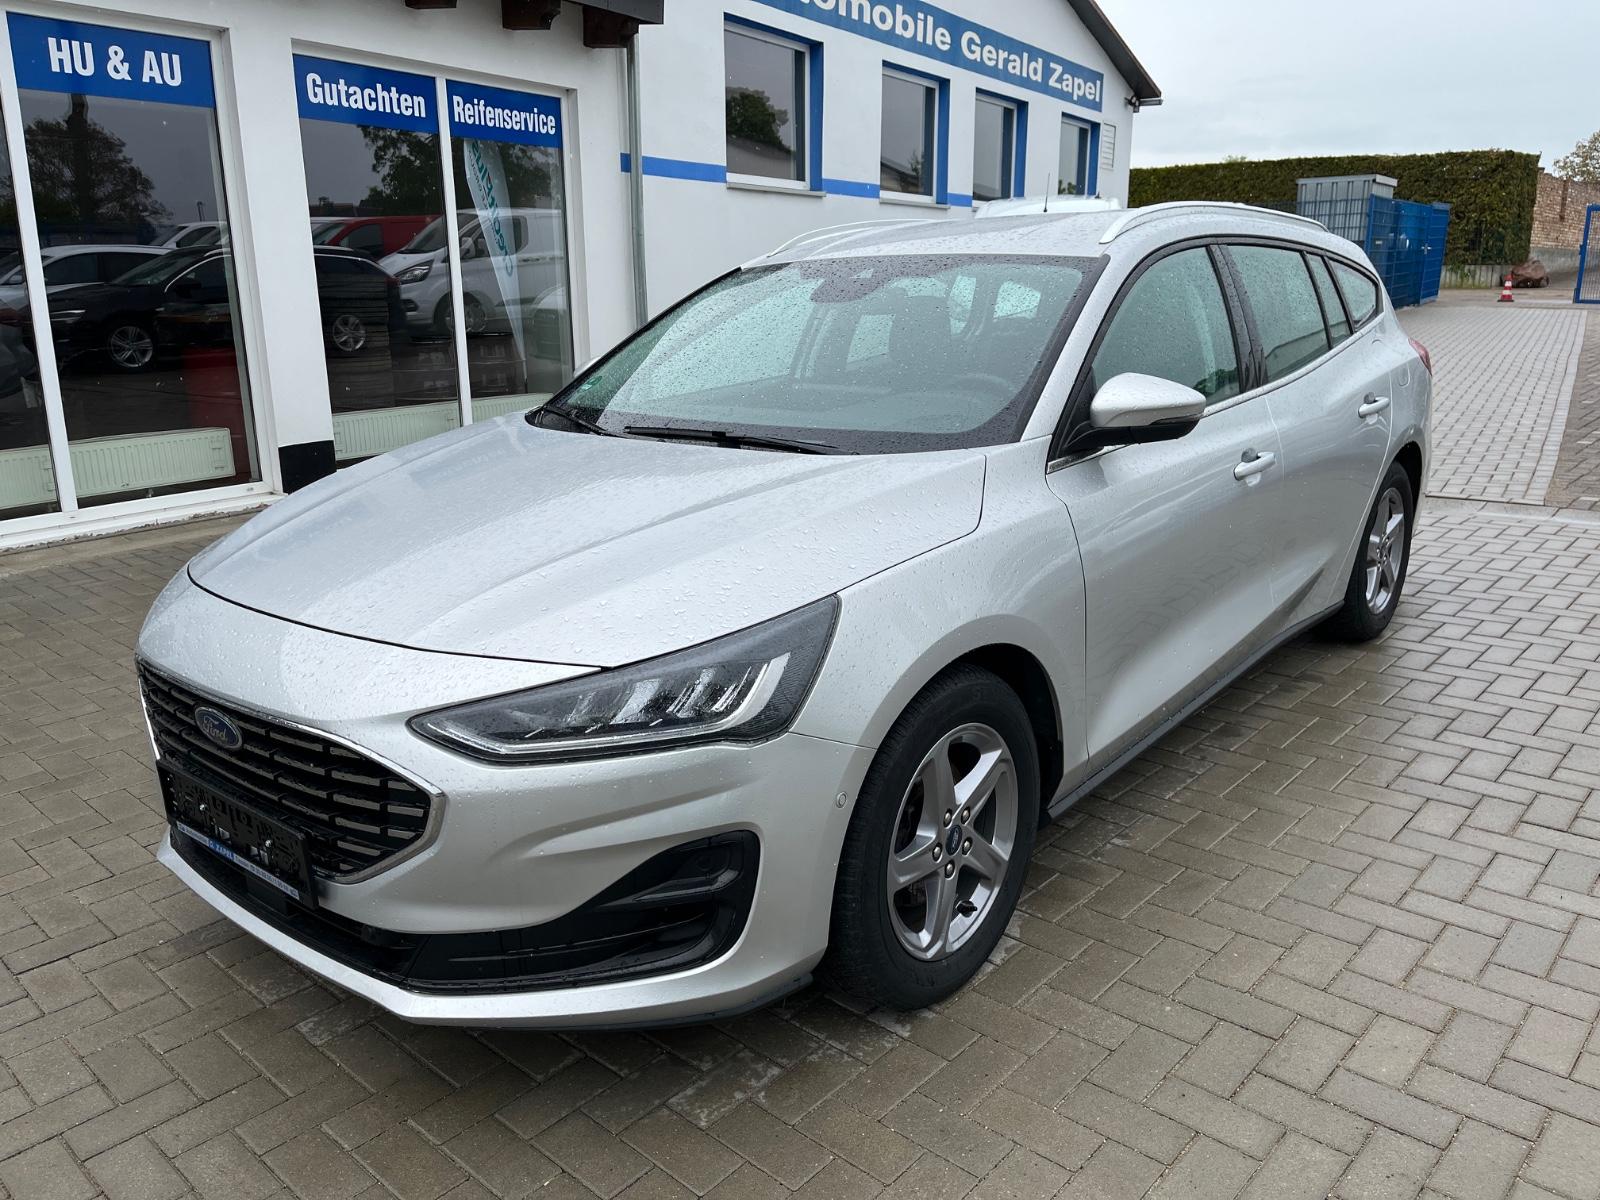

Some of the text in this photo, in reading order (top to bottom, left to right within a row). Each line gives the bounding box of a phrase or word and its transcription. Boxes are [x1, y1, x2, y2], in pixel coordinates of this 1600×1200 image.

[48, 37, 182, 87] HU & AU
[800, 0, 1101, 102] mobile Gerald Zapel
[306, 72, 426, 118] Gutachten
[452, 95, 556, 135] Reifenservice
[202, 715, 228, 741] Ford
